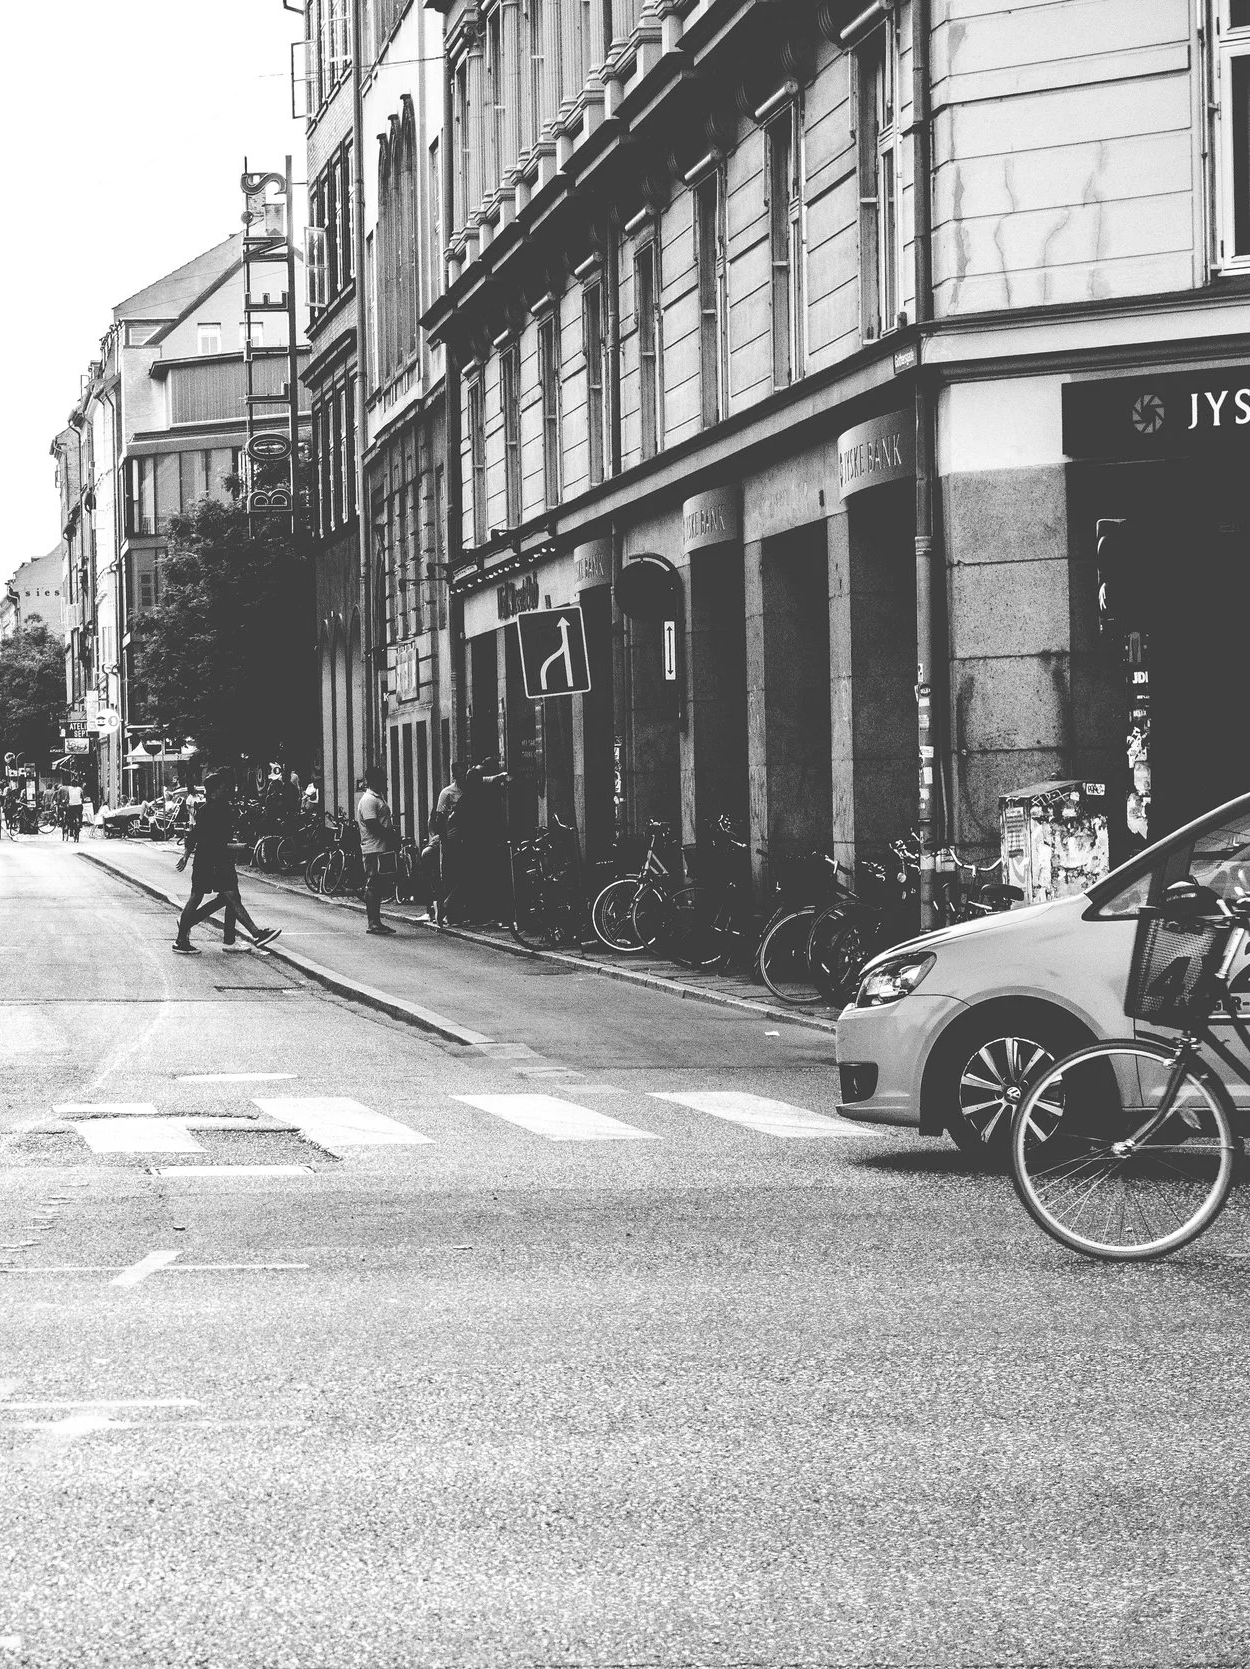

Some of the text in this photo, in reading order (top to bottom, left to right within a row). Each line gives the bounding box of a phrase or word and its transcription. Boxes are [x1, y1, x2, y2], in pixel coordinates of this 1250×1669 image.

[1187, 388, 1250, 430] JYS
[867, 433, 902, 474] BANK
[700, 503, 726, 536] BANK
